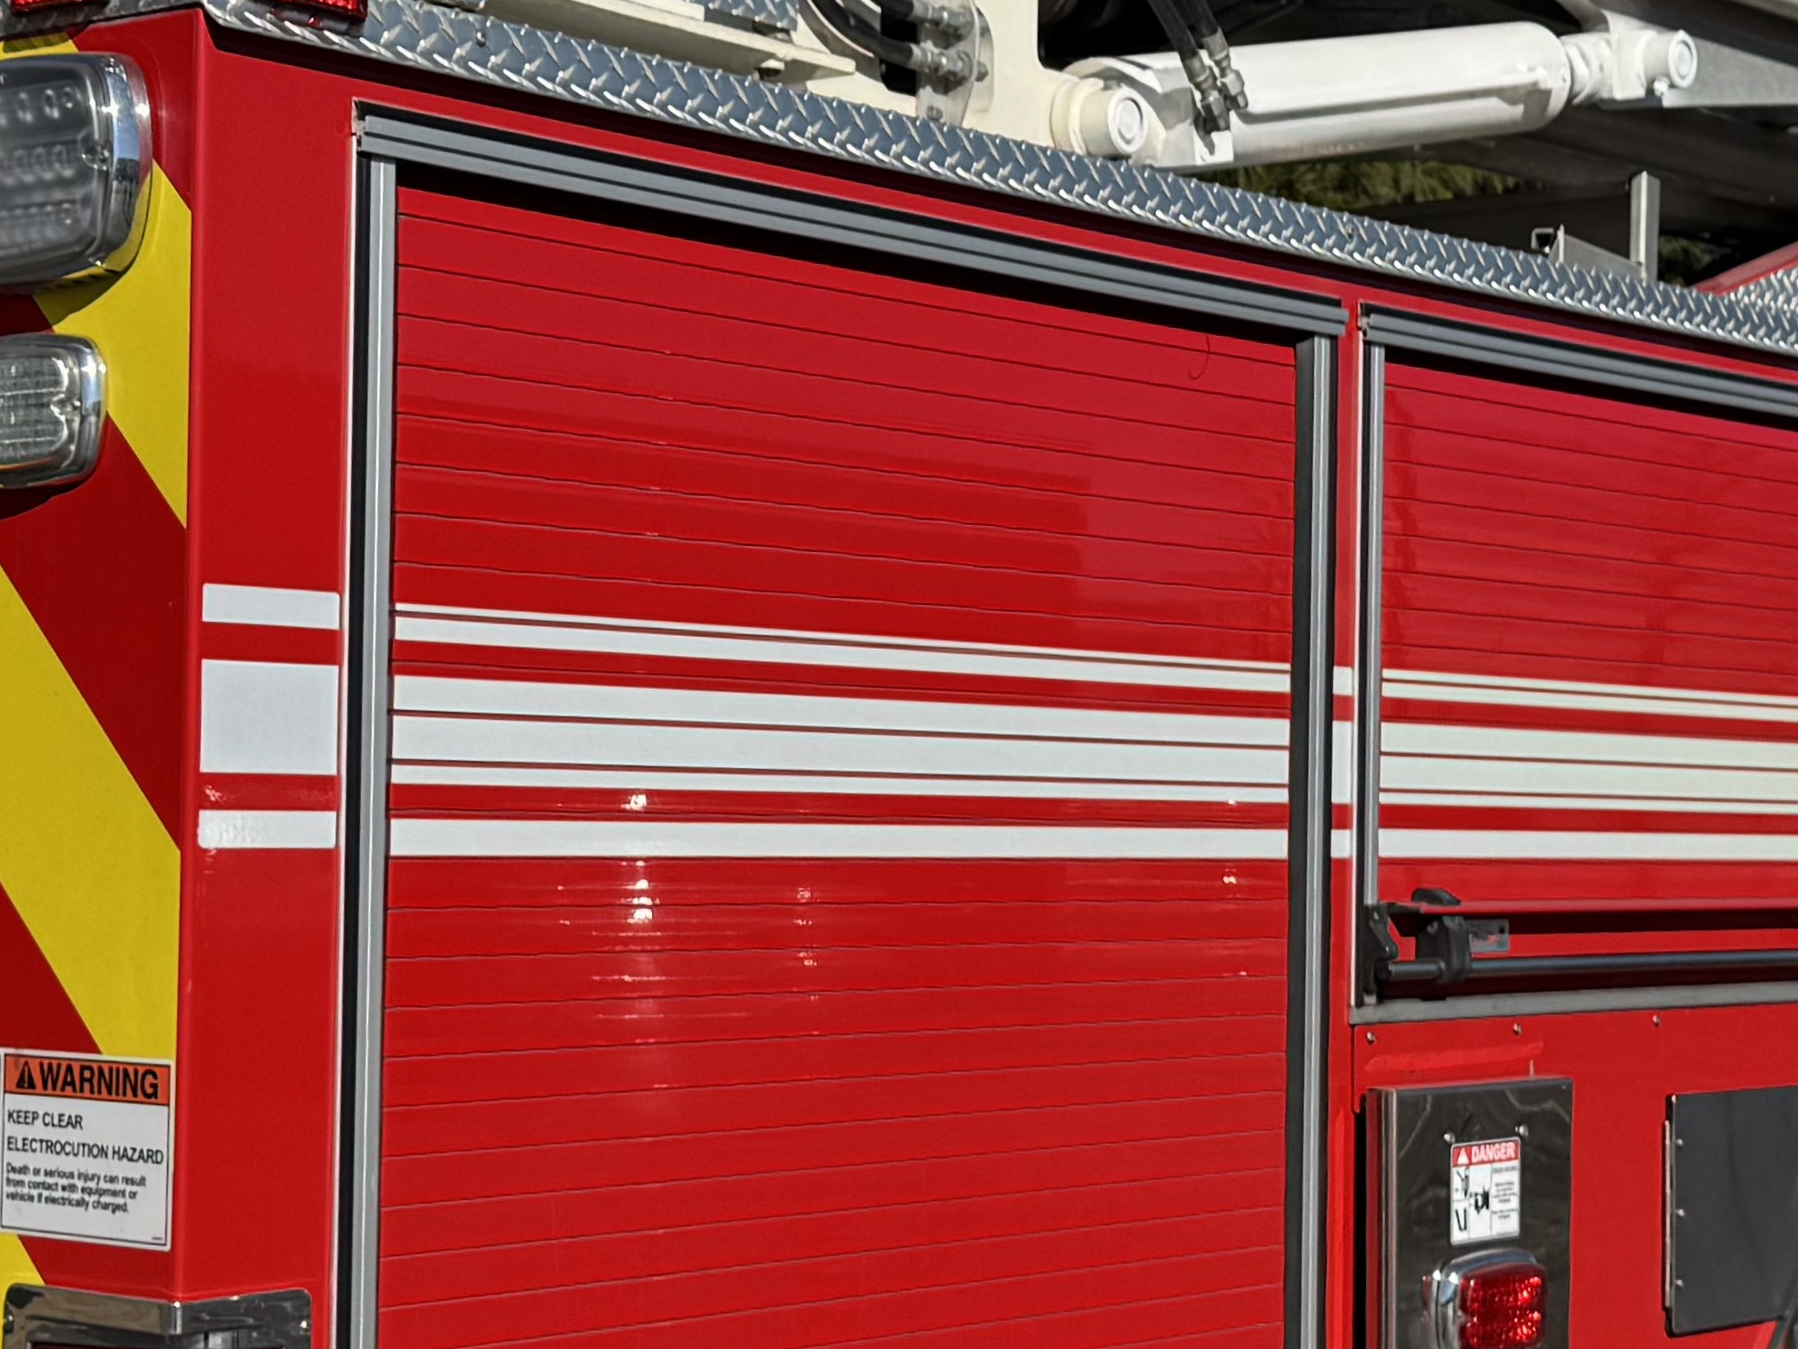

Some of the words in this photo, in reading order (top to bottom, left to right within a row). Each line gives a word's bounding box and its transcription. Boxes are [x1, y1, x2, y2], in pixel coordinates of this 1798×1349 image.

[39, 1061, 159, 1100] WARNING
[7, 1109, 39, 1125] KEEP
[42, 1111, 83, 1130] CLEAR
[7, 1136, 109, 1159] ELECTROCUTION
[112, 1145, 164, 1165] HAZARD
[1471, 1142, 1516, 1161] DANGER
[6, 1161, 30, 1175] Death
[32, 1166, 41, 1176] or
[43, 1167, 75, 1180] serious
[77, 1170, 101, 1185] injury
[103, 1173, 119, 1184] can
[122, 1175, 146, 1187] result
[5, 1177, 26, 1188] from
[27, 1180, 59, 1192] contact
[61, 1183, 79, 1193] with
[81, 1186, 126, 1200] equipment
[128, 1190, 138, 1199] or
[5, 1191, 35, 1203] vehicle
[44, 1194, 89, 1211] electrically
[92, 1200, 129, 1214] charged.
